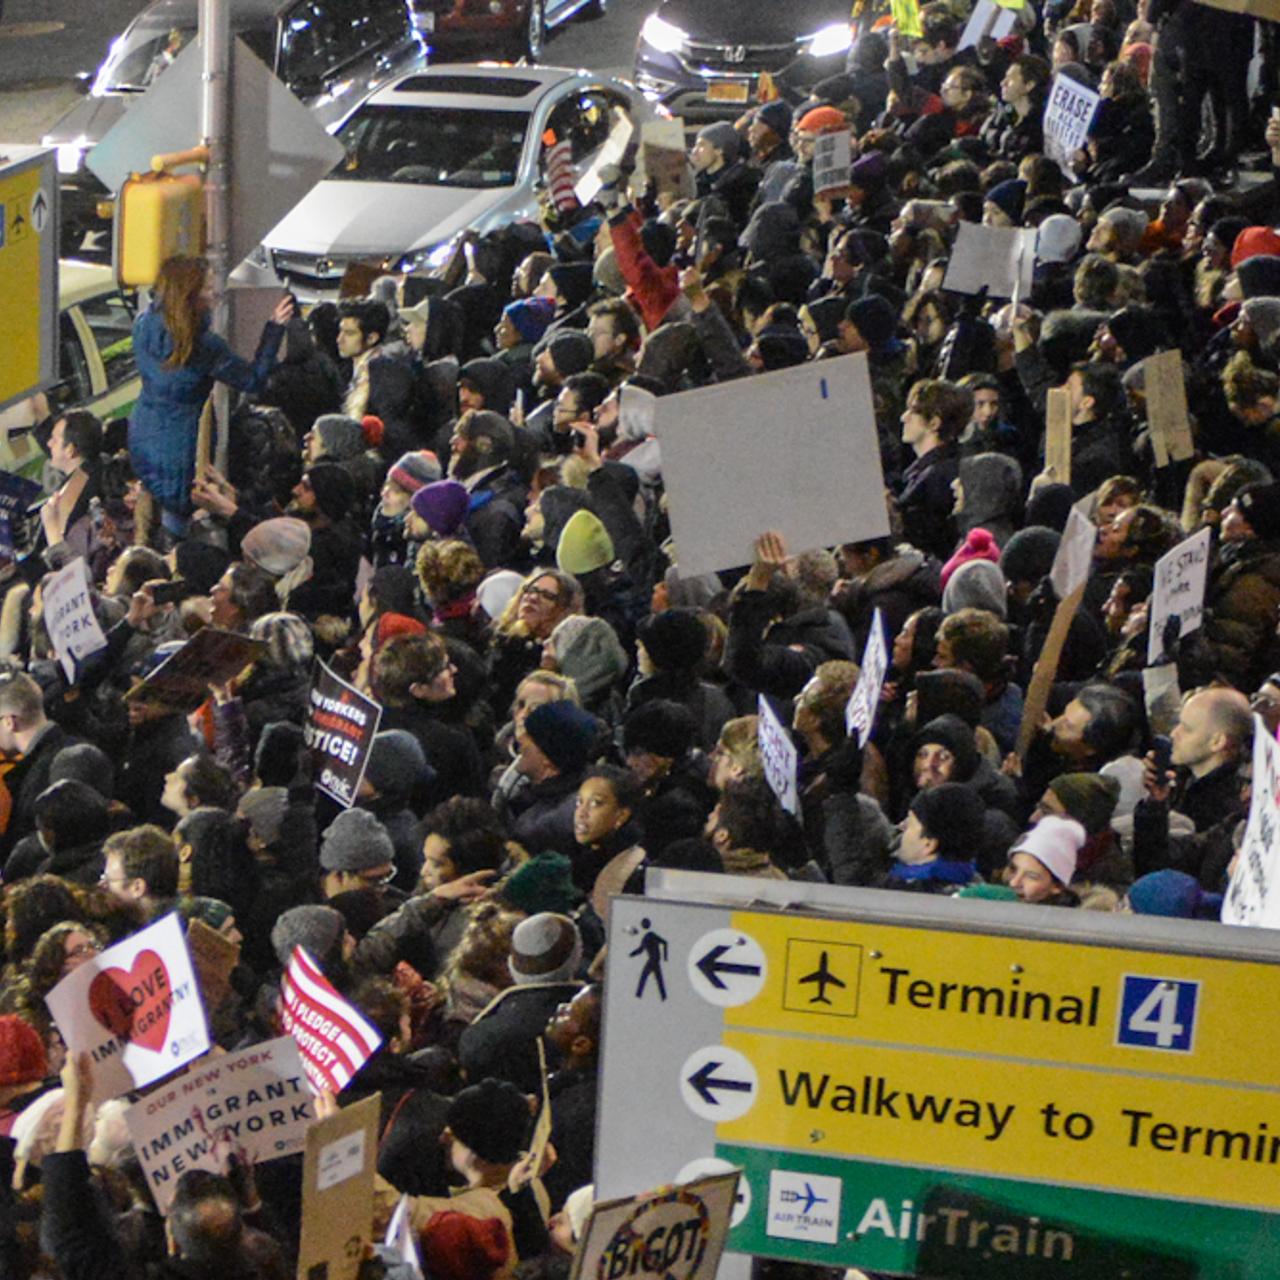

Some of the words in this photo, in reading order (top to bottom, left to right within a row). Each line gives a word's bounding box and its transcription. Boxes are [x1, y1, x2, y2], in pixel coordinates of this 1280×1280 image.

[1053, 85, 1092, 122] ERASE
[116, 965, 168, 1019] LOVE
[295, 1001, 342, 1043] PLEDGE
[879, 965, 1101, 1028] Terminal
[1127, 981, 1184, 1048] 4
[291, 1022, 337, 1068] PROTECT
[145, 1089, 178, 1117] OUR
[182, 1066, 222, 1096] NEW
[225, 1049, 275, 1074] YORK
[777, 1068, 1017, 1142] Walkway
[1040, 1101, 1094, 1141] to
[140, 1075, 302, 1162] IMMIGRANT
[151, 1138, 210, 1188] NEW
[224, 1101, 313, 1139] YORK
[856, 1198, 1075, 1262] AirTrain
